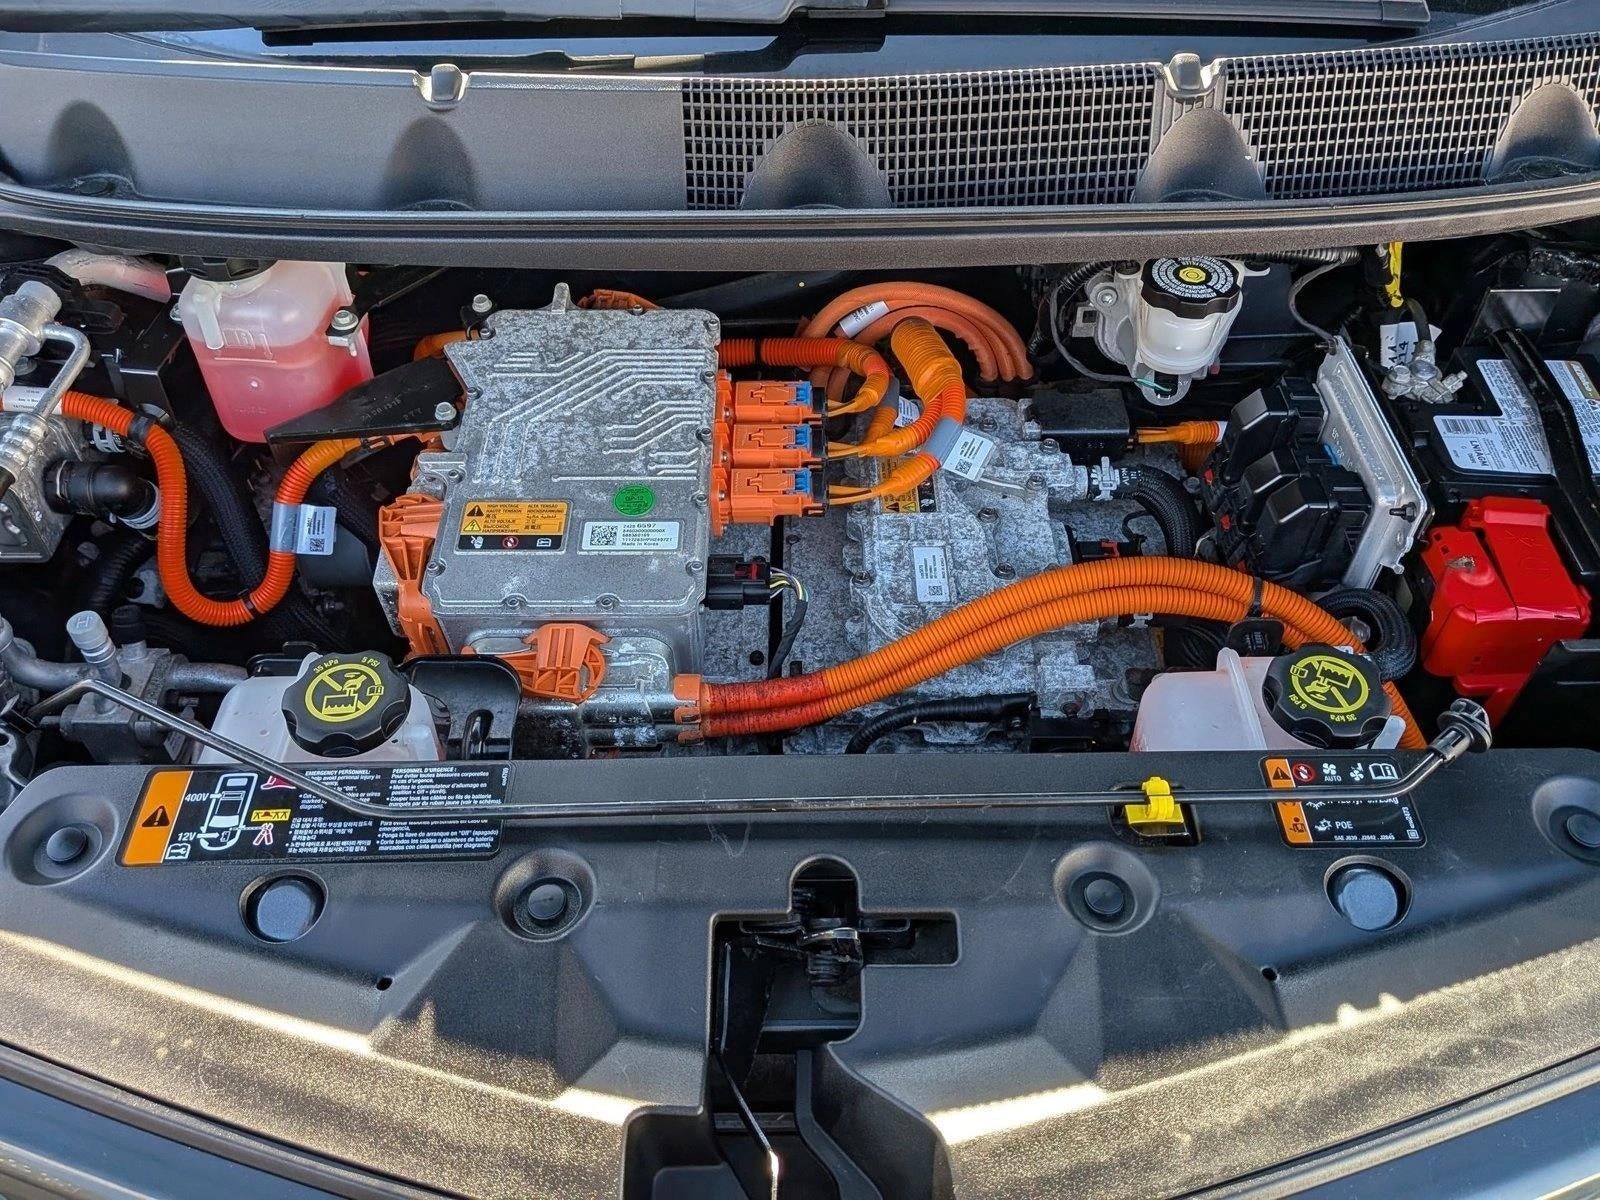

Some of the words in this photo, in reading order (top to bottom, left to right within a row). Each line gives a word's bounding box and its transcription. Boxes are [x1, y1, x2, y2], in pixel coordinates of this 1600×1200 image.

[313, 665, 324, 674] 35
[323, 659, 339, 669] kPa
[366, 657, 381, 667] PSI
[1288, 694, 1301, 705] PSI
[1330, 714, 1346, 722] kPa
[185, 793, 209, 802] 400V
[1335, 821, 1354, 829] POE
[178, 832, 196, 841] 12V
